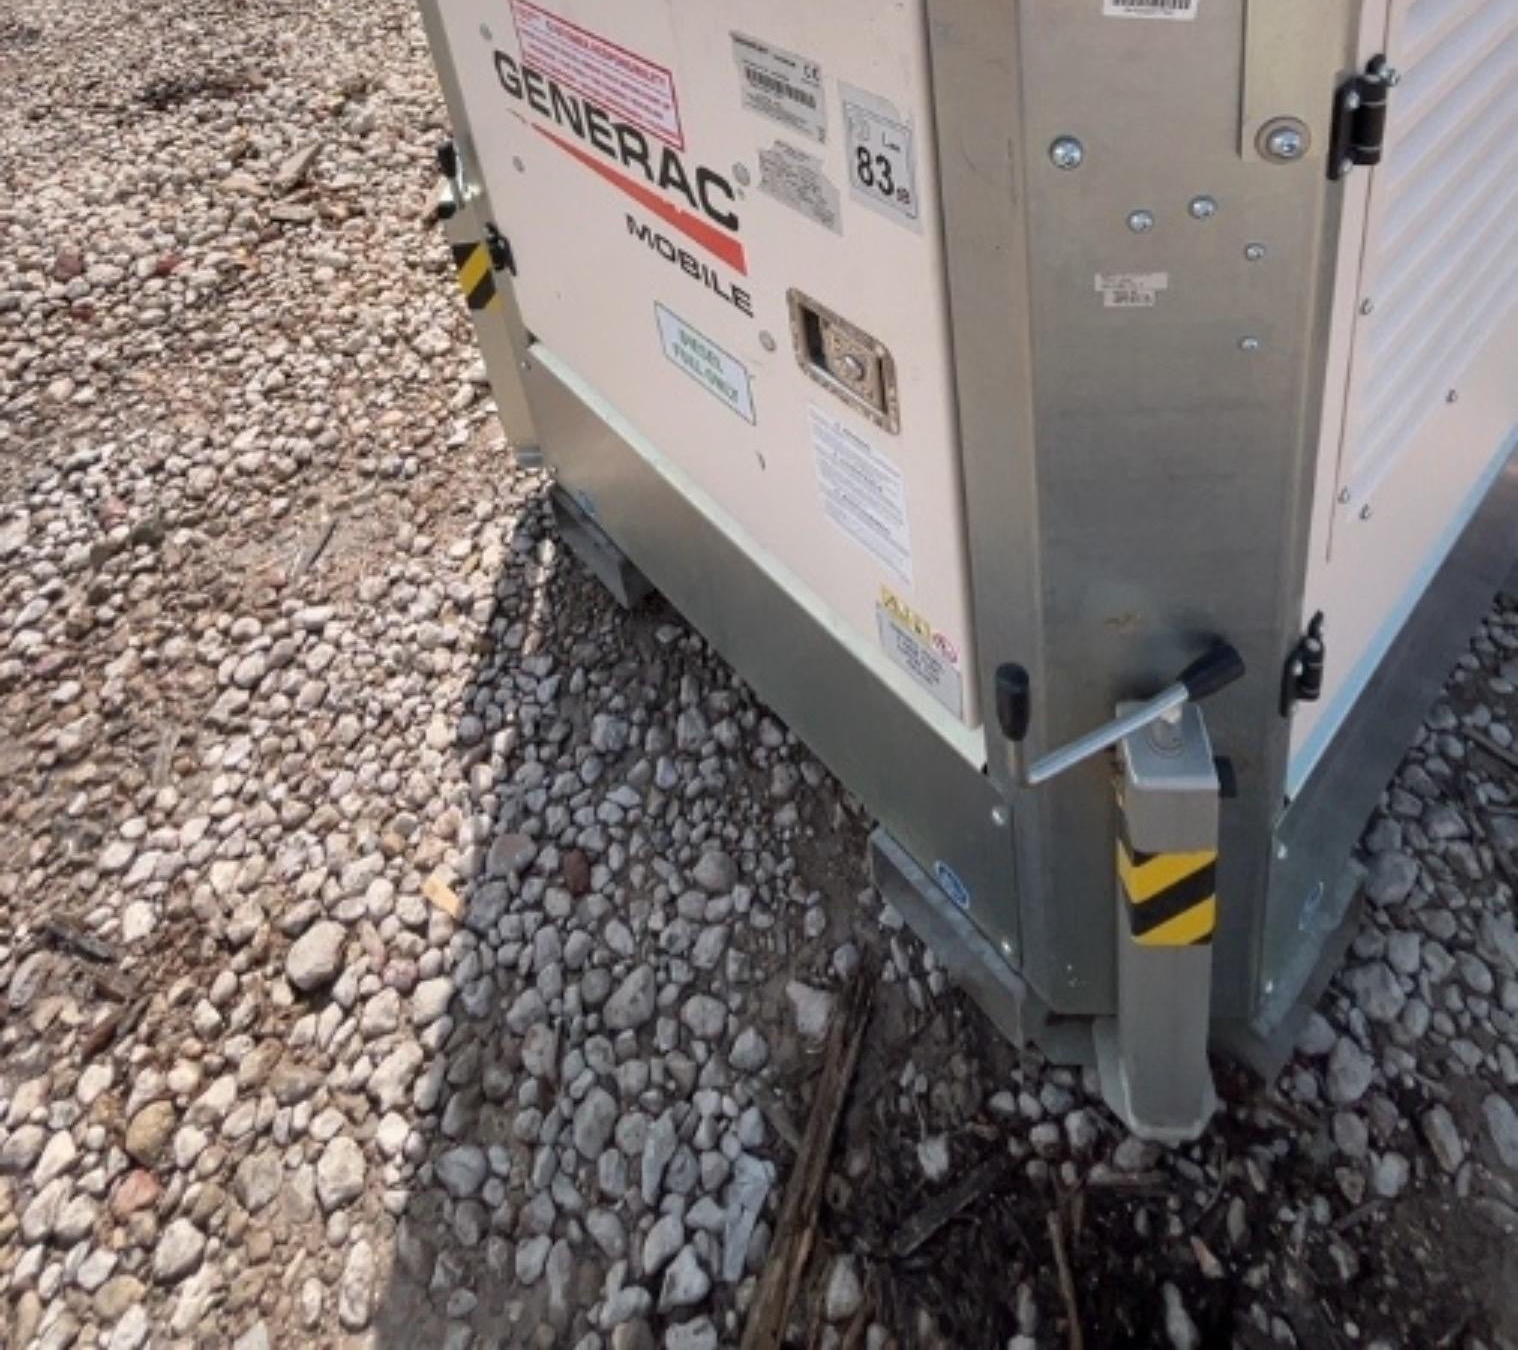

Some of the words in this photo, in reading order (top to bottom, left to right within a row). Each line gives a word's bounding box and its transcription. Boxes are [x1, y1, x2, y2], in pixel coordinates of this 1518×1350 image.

[493, 49, 739, 232] GENERAC
[856, 145, 895, 196] 83
[625, 213, 754, 317] MOBILE
